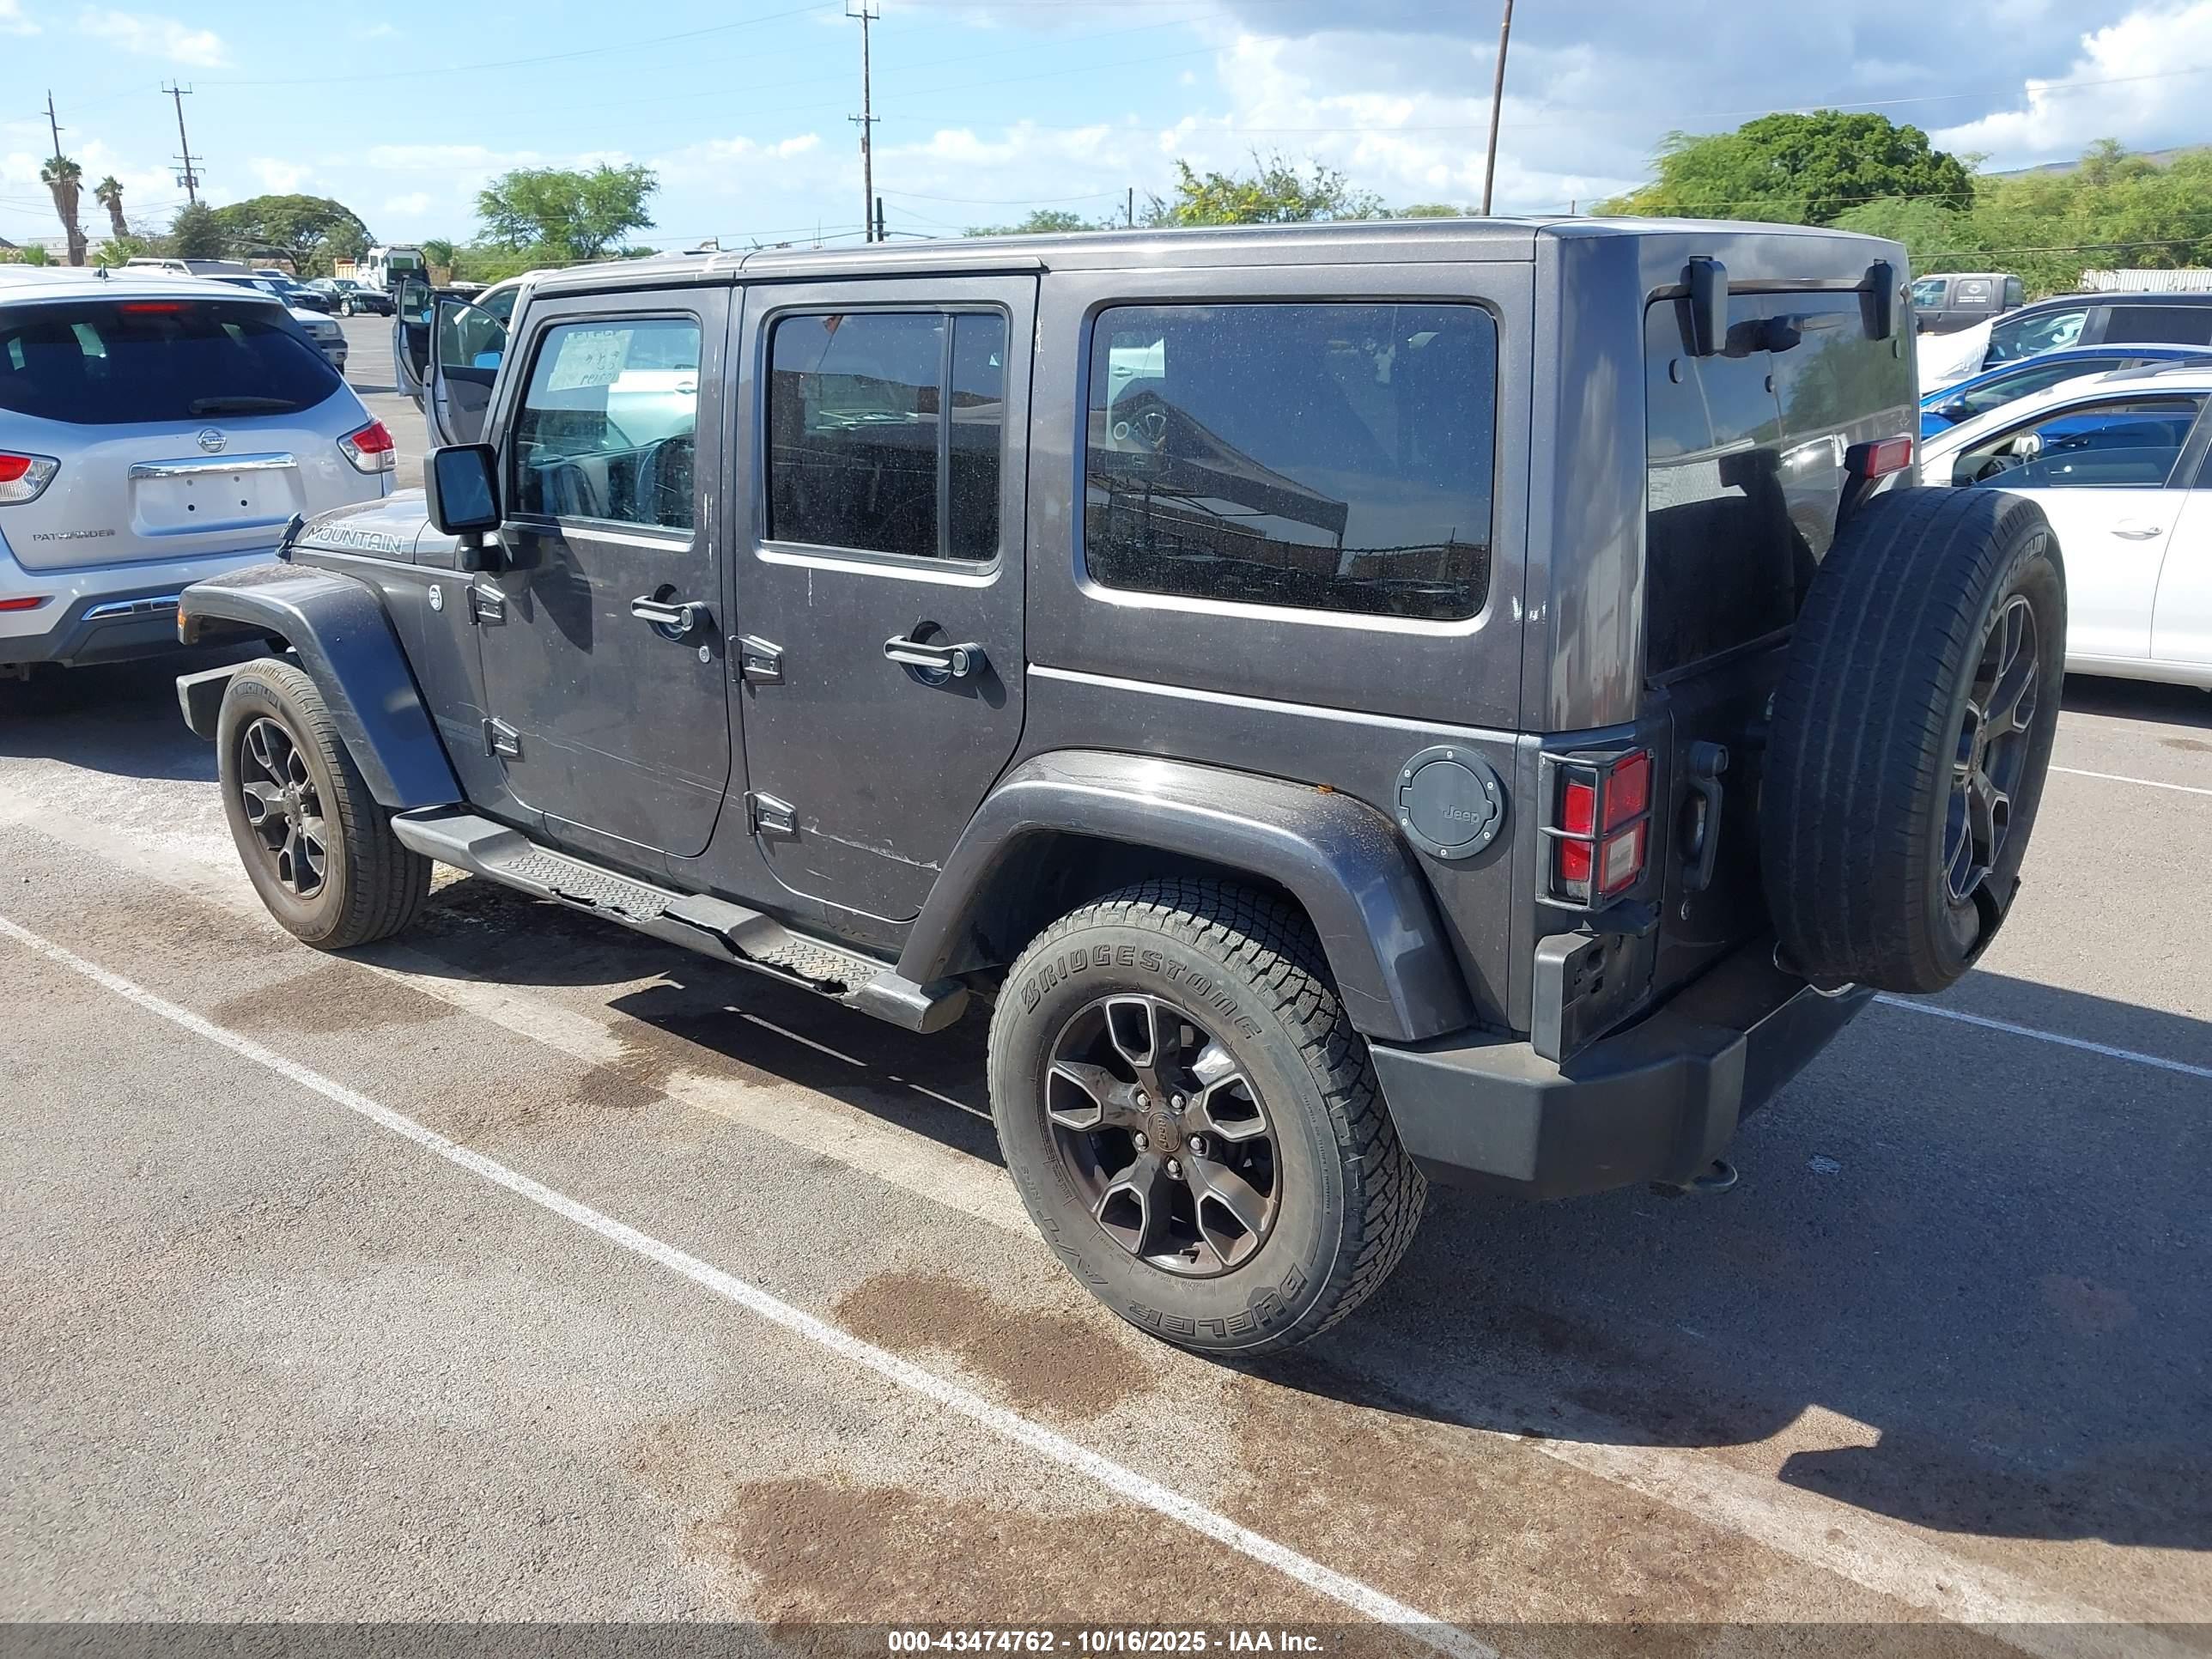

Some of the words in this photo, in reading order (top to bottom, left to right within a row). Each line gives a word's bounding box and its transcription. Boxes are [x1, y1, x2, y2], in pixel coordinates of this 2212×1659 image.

[301, 525, 405, 555] MOUNTAIN
[1443, 805, 1480, 824] Jeep
[1019, 943, 1263, 1041] BRIDGESTONE
[1129, 1263, 1309, 1339] DUELER
